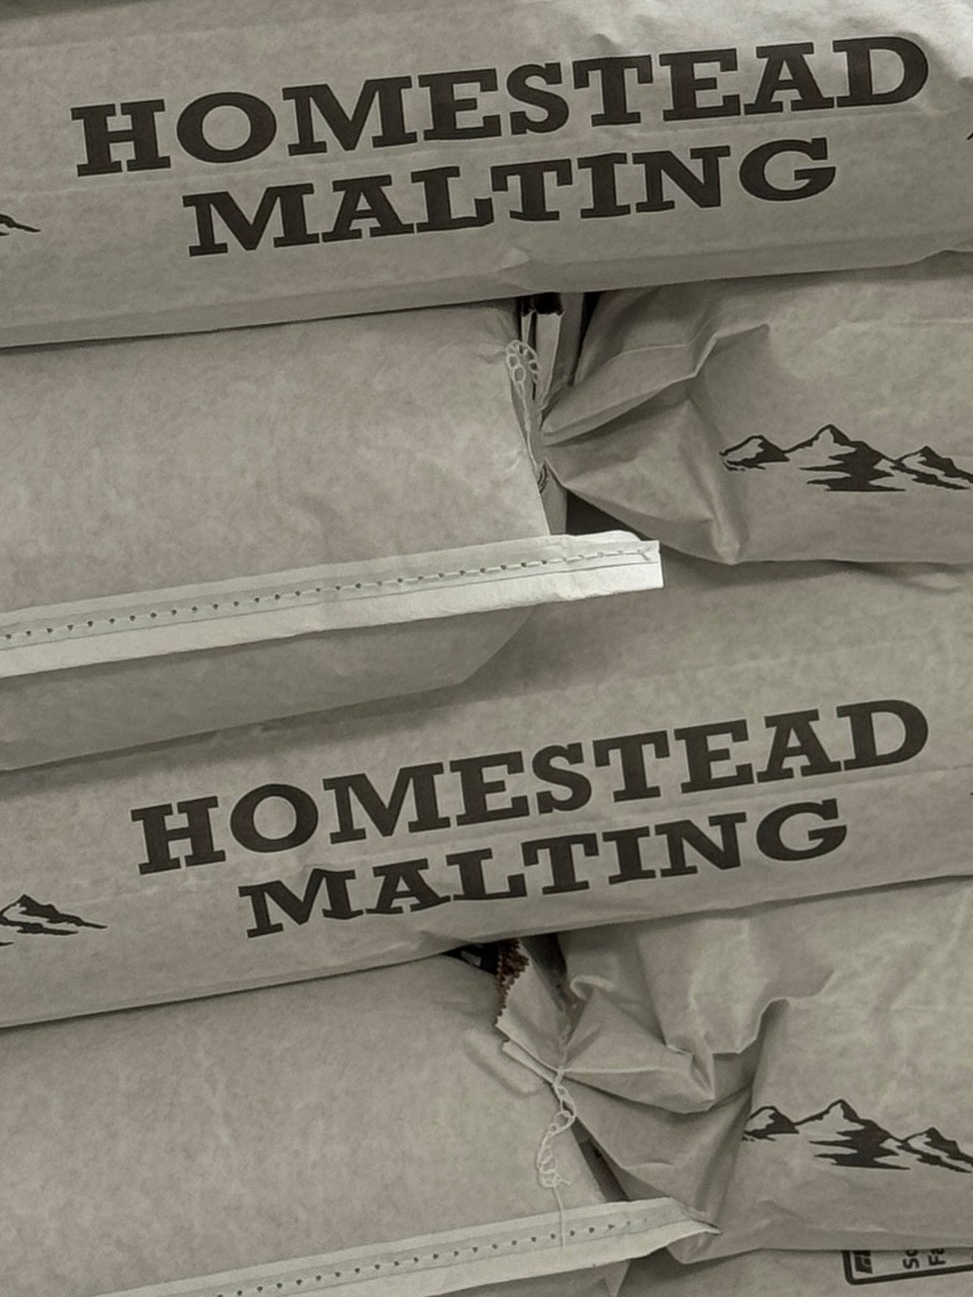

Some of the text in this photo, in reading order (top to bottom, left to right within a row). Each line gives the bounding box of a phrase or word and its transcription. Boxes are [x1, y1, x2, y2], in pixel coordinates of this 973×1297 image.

[70, 35, 929, 177] HOMESTEAD
[183, 137, 836, 257] MALTING
[131, 699, 929, 876] HOMESTEAD
[237, 799, 848, 939] MALTING
